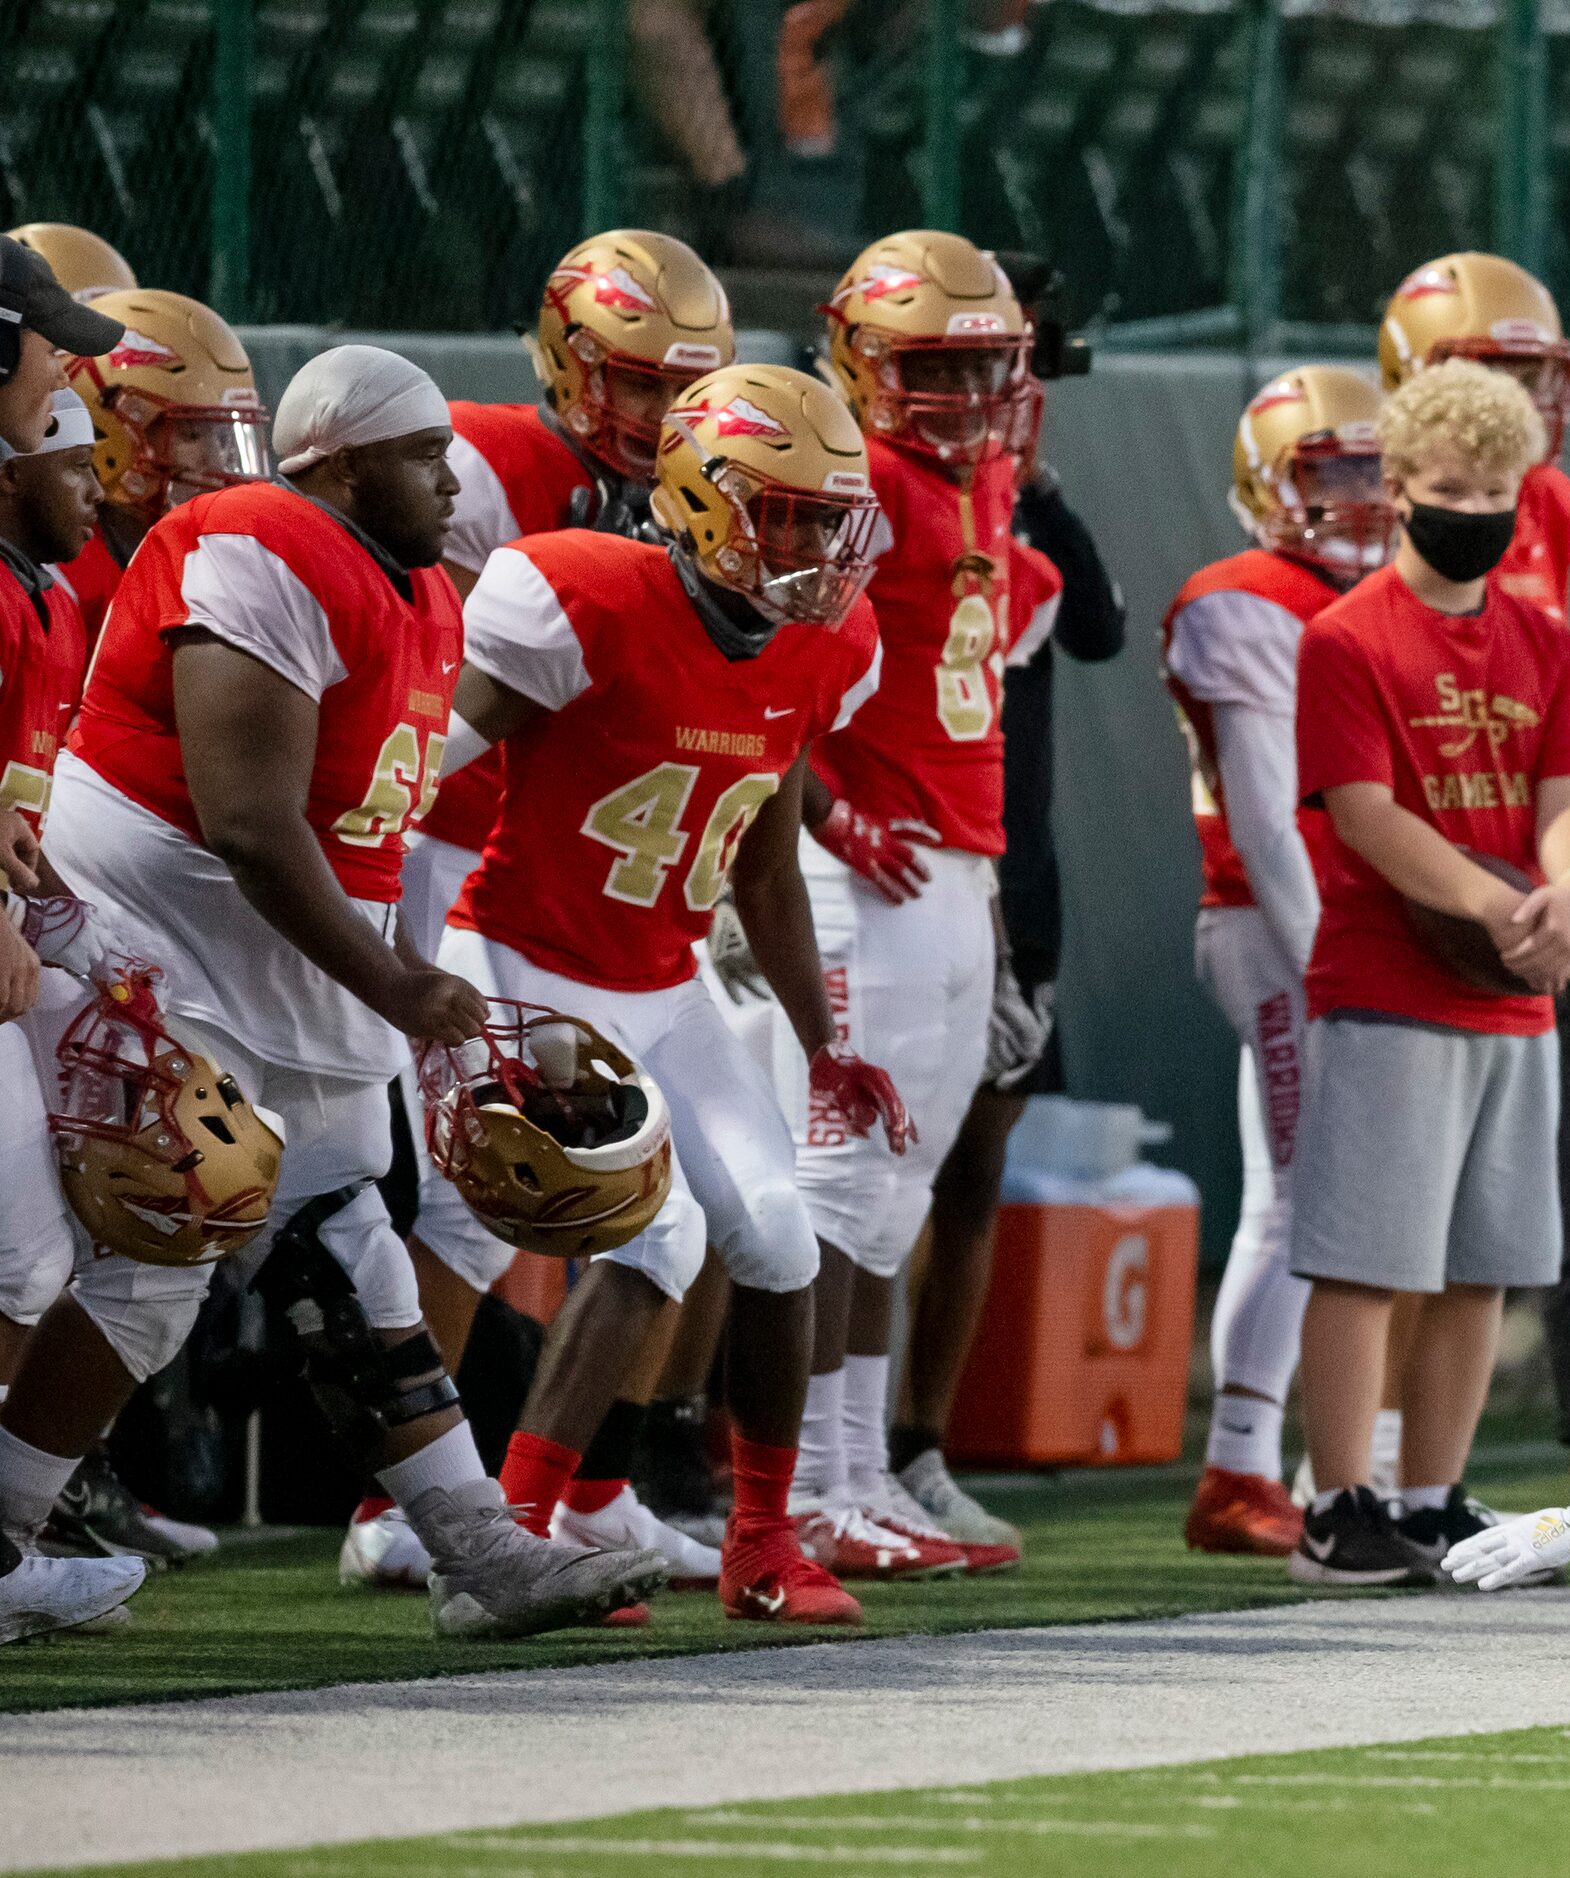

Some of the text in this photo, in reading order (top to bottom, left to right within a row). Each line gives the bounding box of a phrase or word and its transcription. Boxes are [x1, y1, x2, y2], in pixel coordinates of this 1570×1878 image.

[934, 595, 1004, 742] 8
[675, 726, 767, 757] WARRIORS
[579, 761, 781, 912] 40
[1104, 1234, 1148, 1348] G
